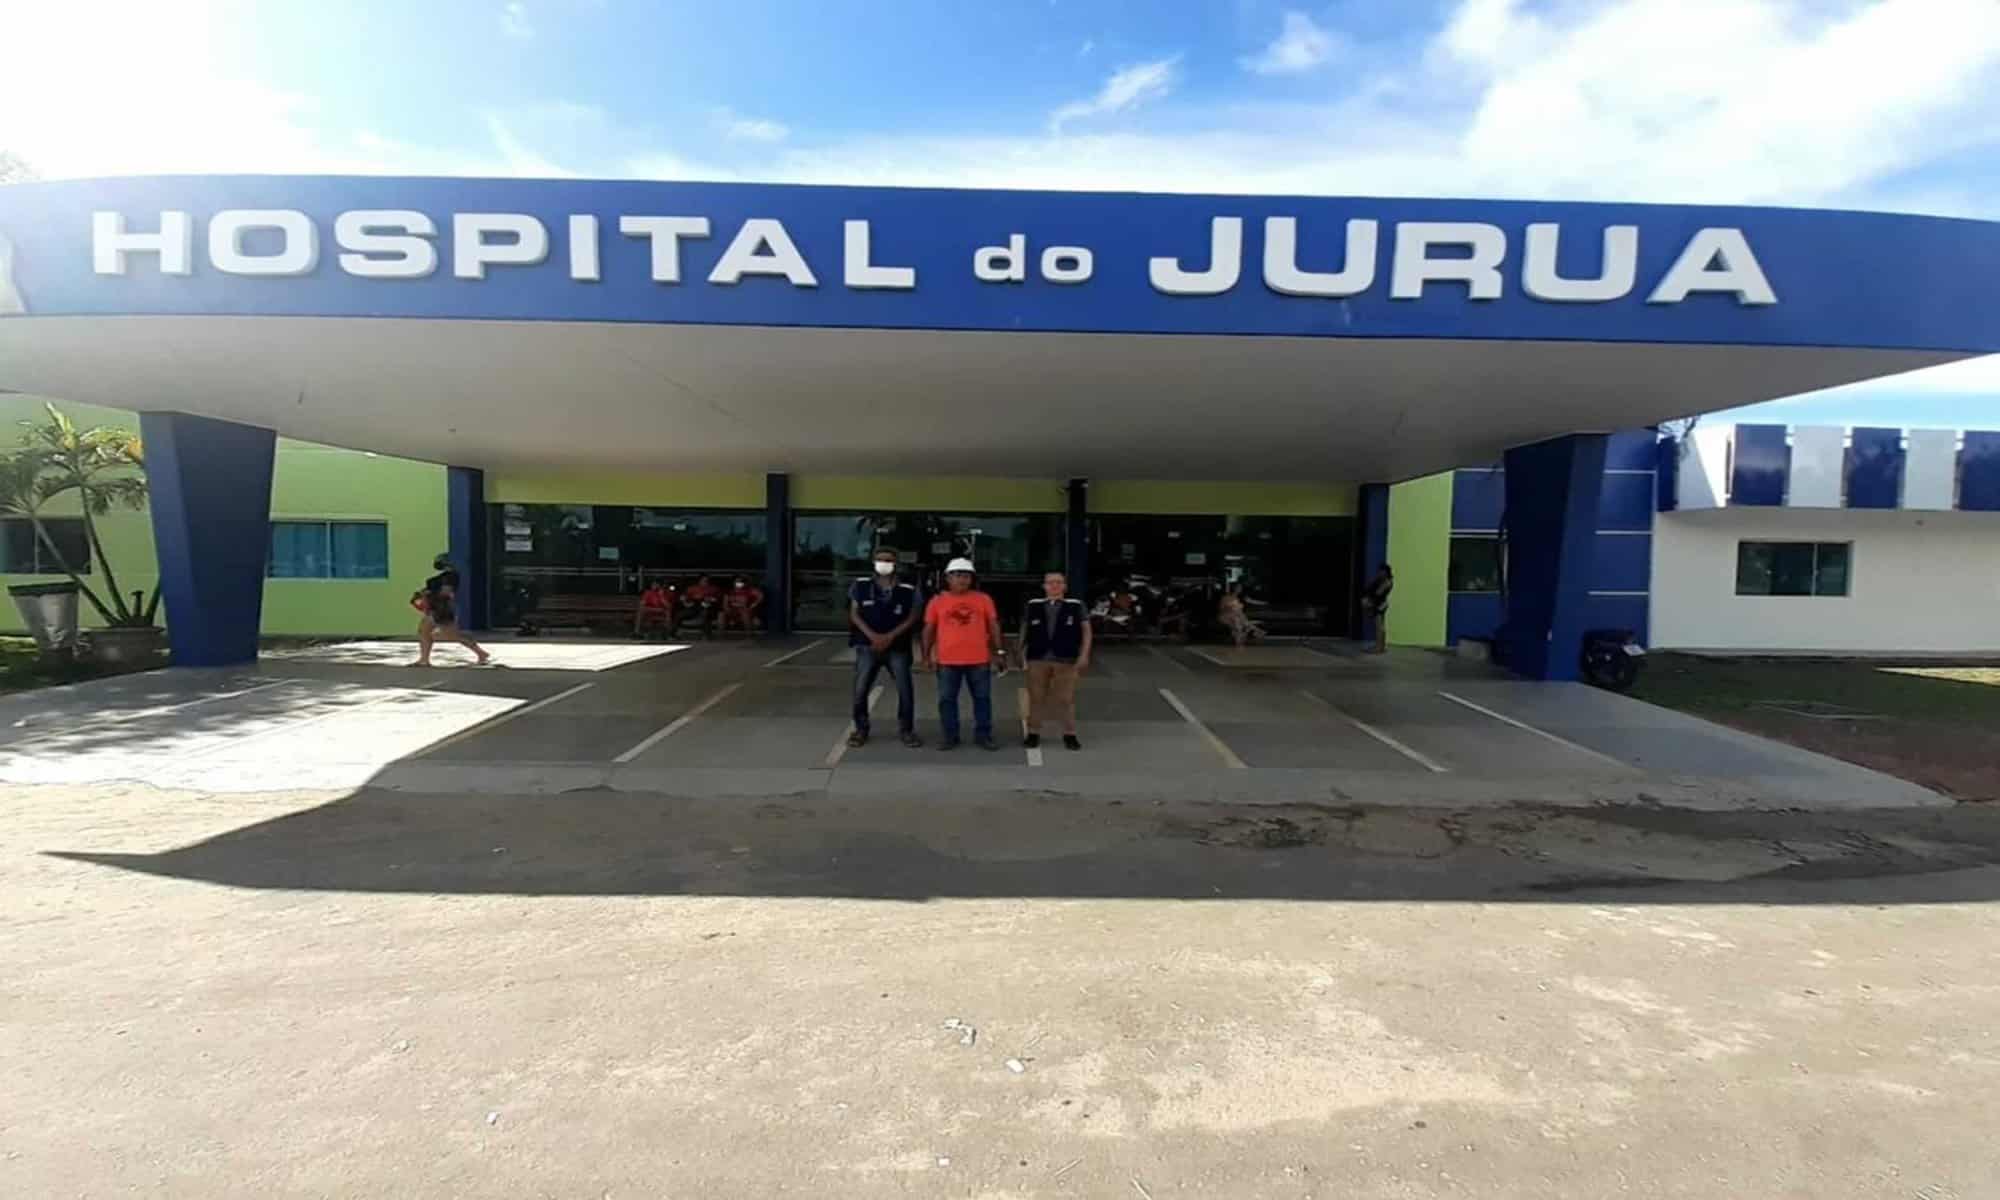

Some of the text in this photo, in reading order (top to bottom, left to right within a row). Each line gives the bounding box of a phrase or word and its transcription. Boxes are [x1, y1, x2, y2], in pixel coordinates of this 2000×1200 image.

[92, 209, 1777, 305] HOSPITAL do JURUA
